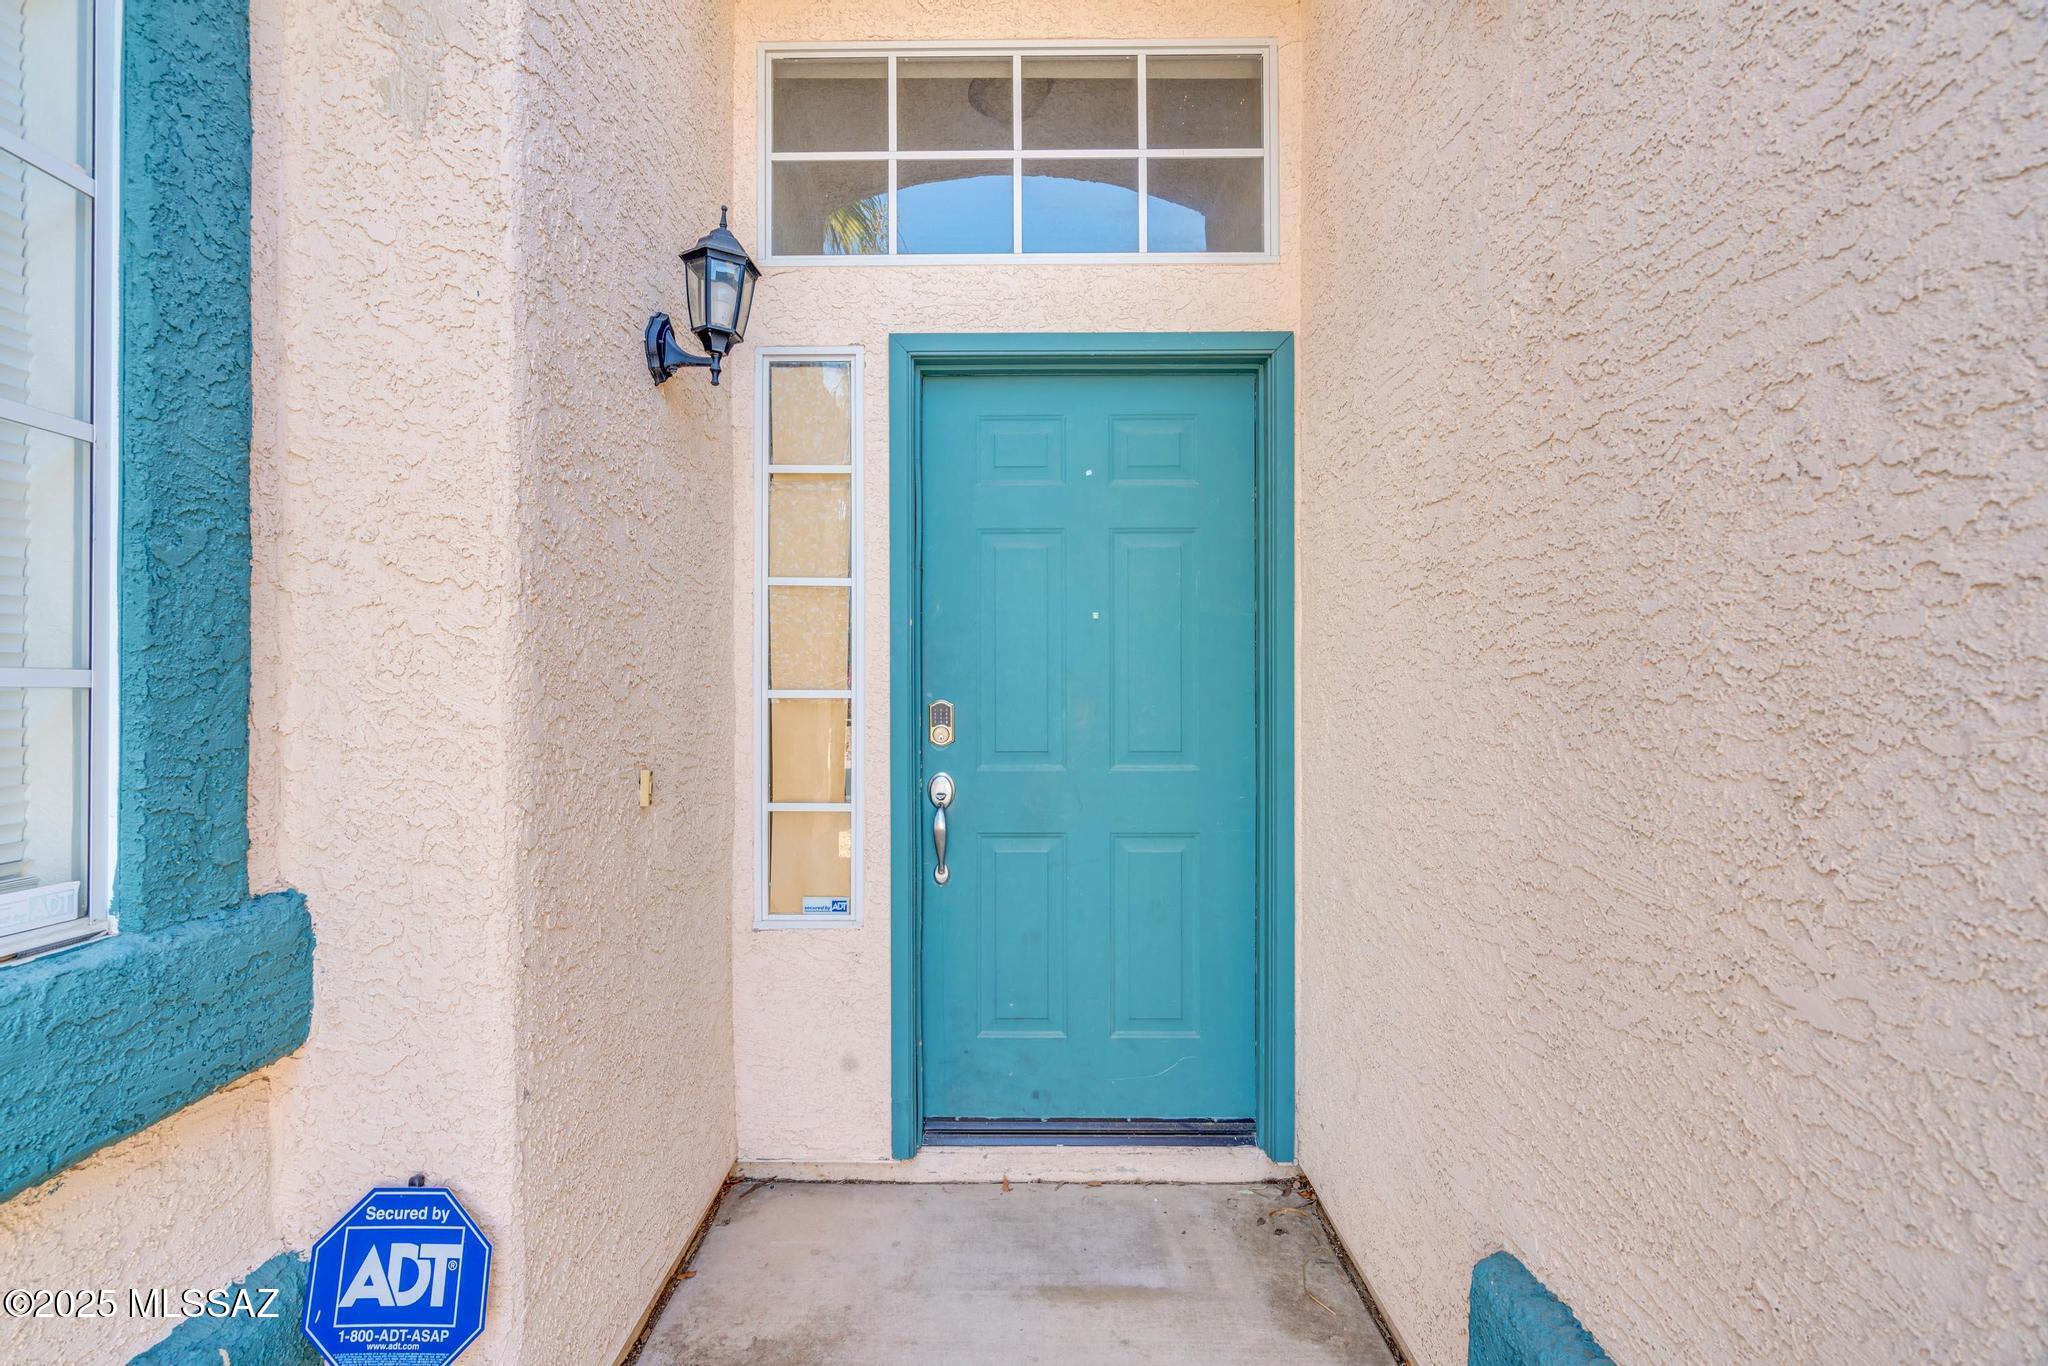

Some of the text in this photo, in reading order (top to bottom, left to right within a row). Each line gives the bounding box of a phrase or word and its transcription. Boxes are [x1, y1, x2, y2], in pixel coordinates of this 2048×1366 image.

[832, 902, 847, 910] ADT
[365, 1206, 450, 1223] Secured by
[338, 1329, 450, 1343] 1-800-ADT-ASAP
